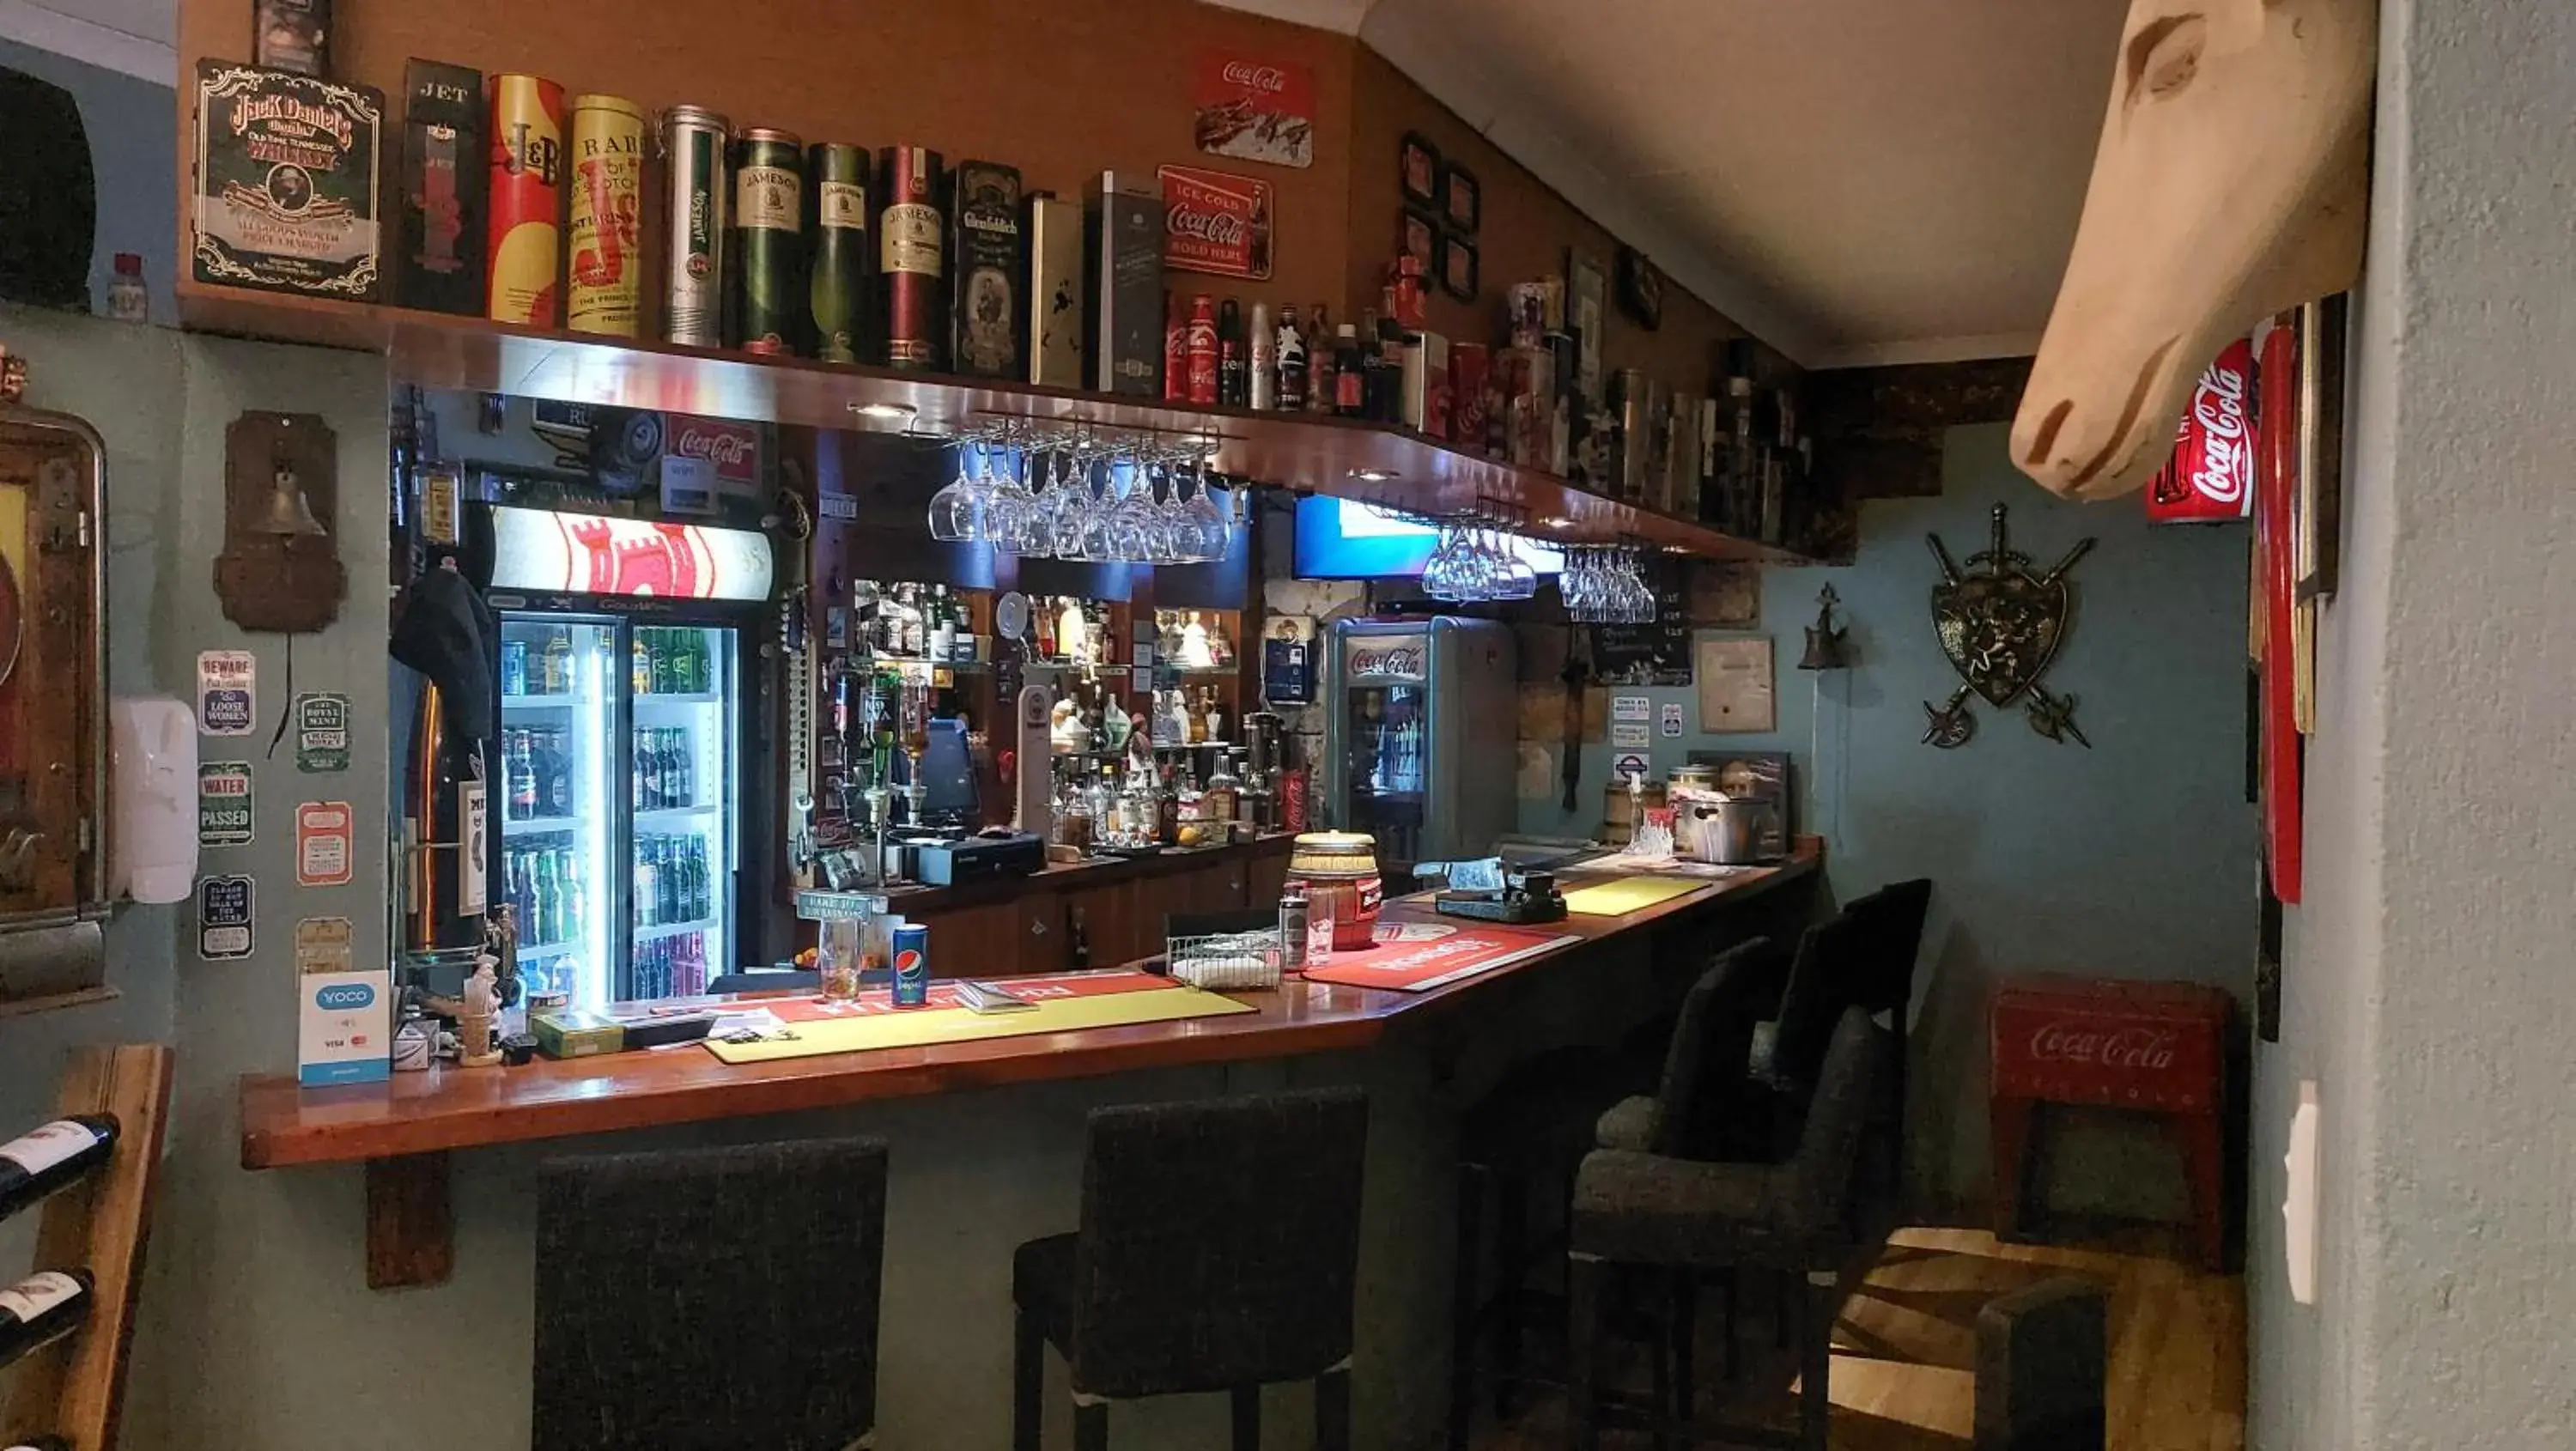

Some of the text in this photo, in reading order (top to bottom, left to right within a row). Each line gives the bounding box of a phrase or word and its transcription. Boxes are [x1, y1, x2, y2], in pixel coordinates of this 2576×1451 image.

[420, 82, 468, 103] JET
[745, 172, 798, 191] JAMESON
[1176, 184, 1241, 210] ICE COLD
[691, 190, 707, 243] JAMESON
[204, 660, 249, 674] BEWARE
[210, 701, 246, 711] LOOSE
[204, 778, 246, 795] WATER
[201, 810, 248, 827] PASSED
[897, 979, 921, 993] pepsi
[325, 1038, 344, 1049] VISA
